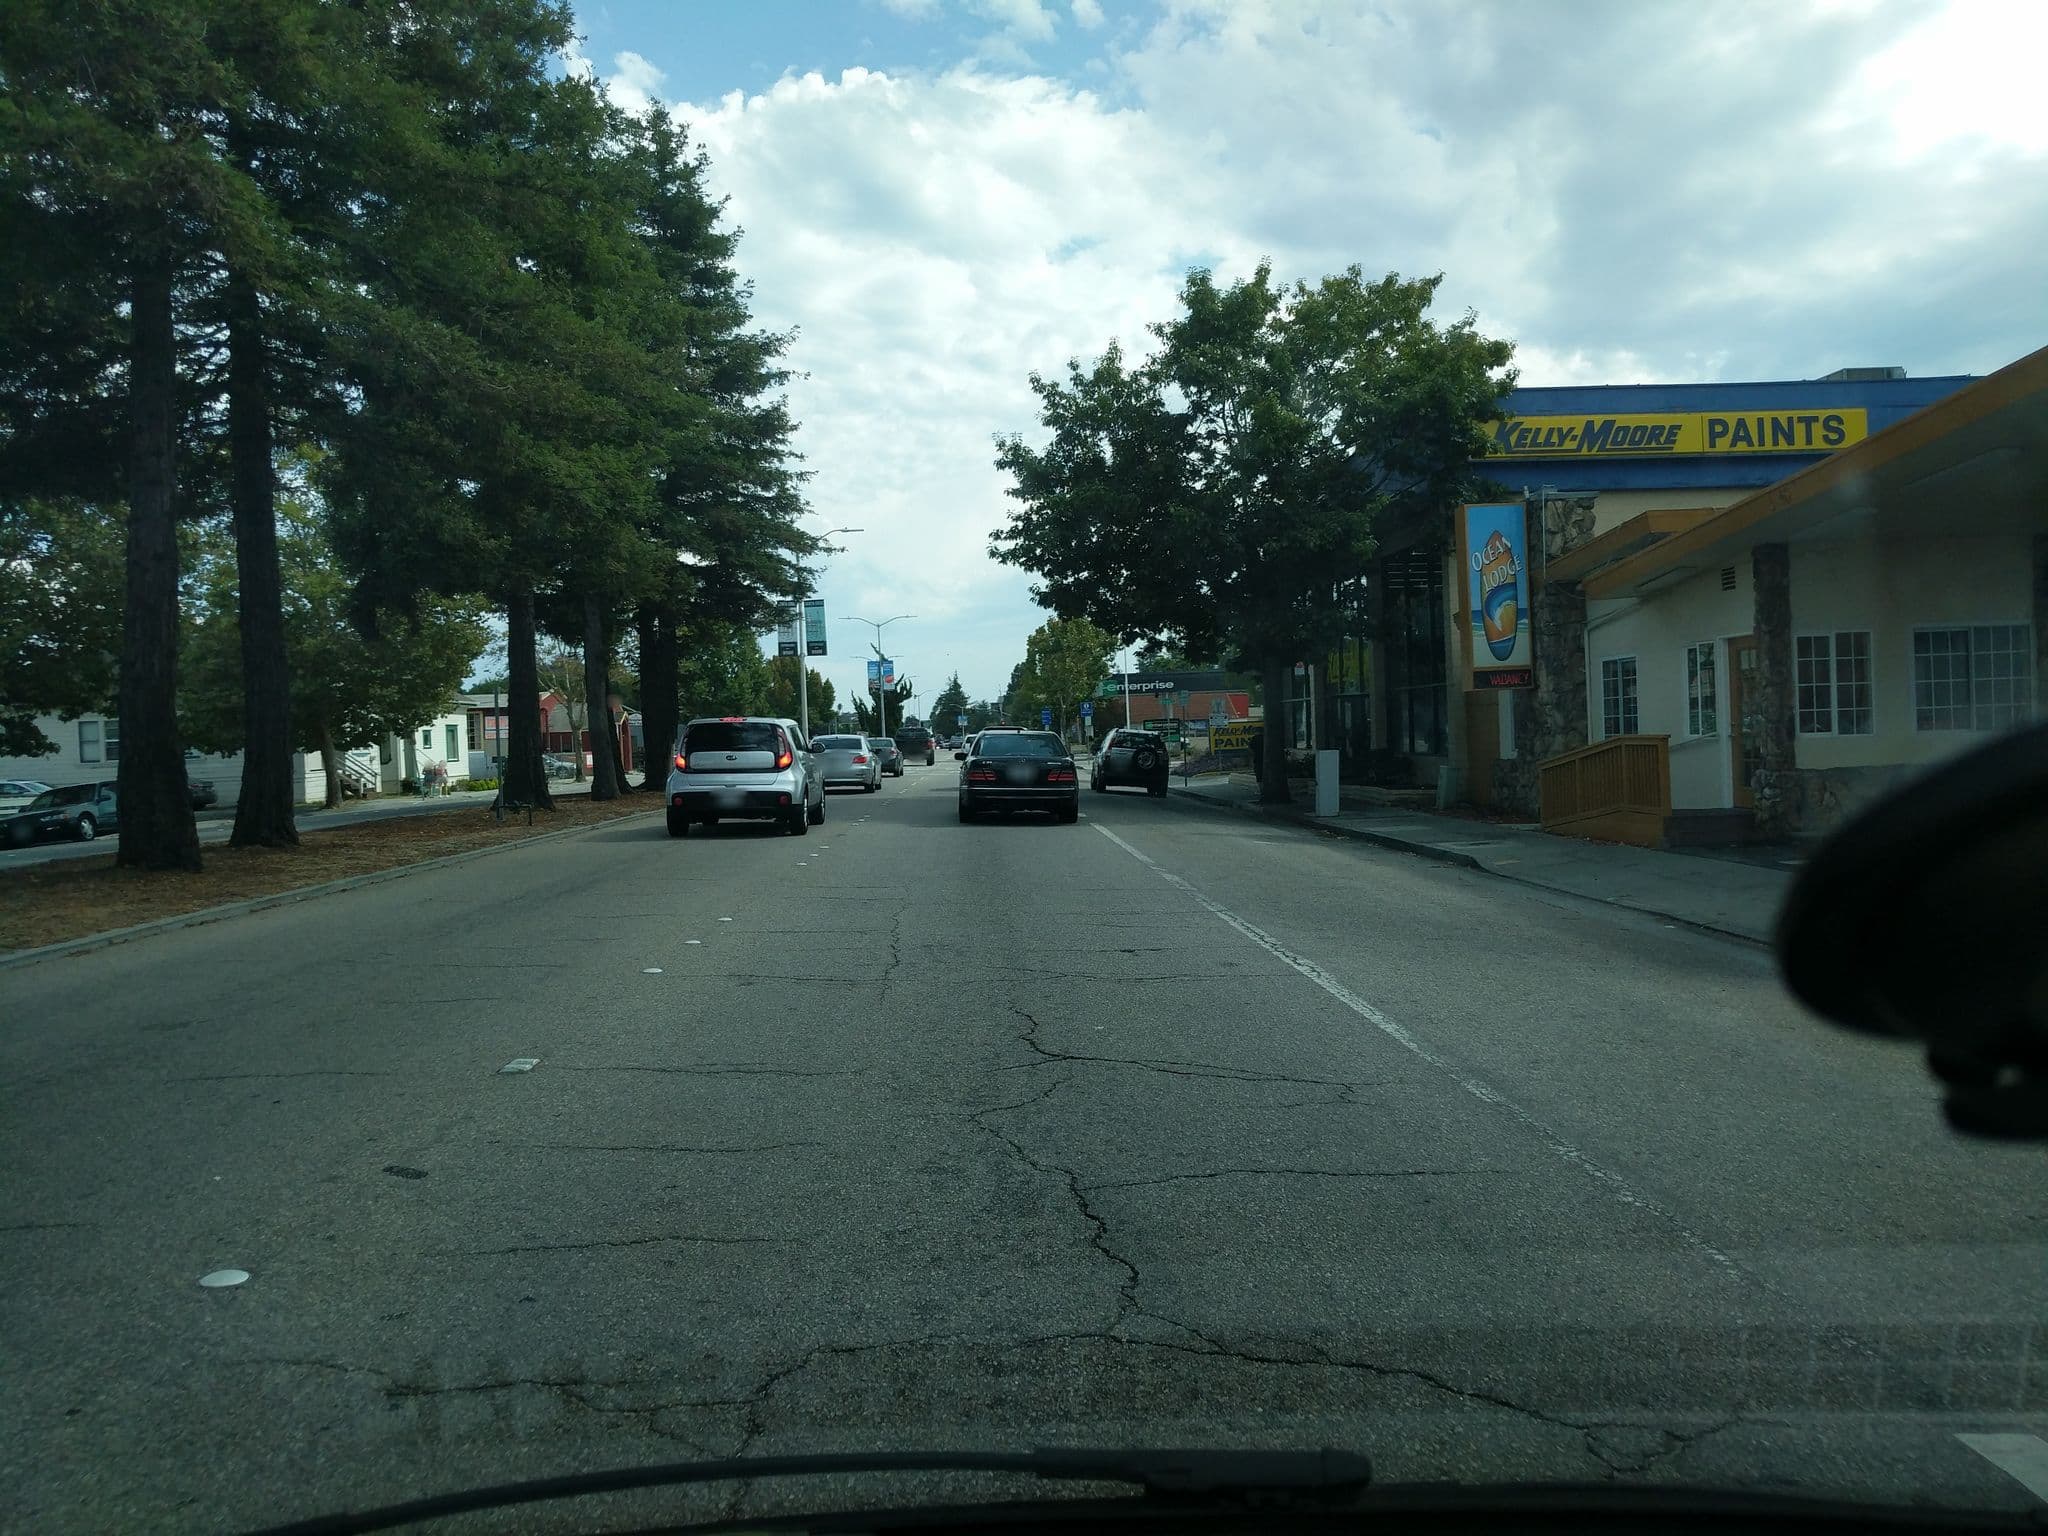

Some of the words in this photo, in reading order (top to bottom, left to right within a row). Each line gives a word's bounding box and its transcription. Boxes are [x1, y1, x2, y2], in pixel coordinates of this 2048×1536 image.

[1496, 419, 1683, 454] KELLY-MOORE
[1707, 415, 1846, 448] PAINTS
[1472, 537, 1511, 571] OCEAN
[1483, 554, 1522, 592] LODGE
[1105, 681, 1174, 692] enterprise
[1215, 738, 1249, 748] PAIN
